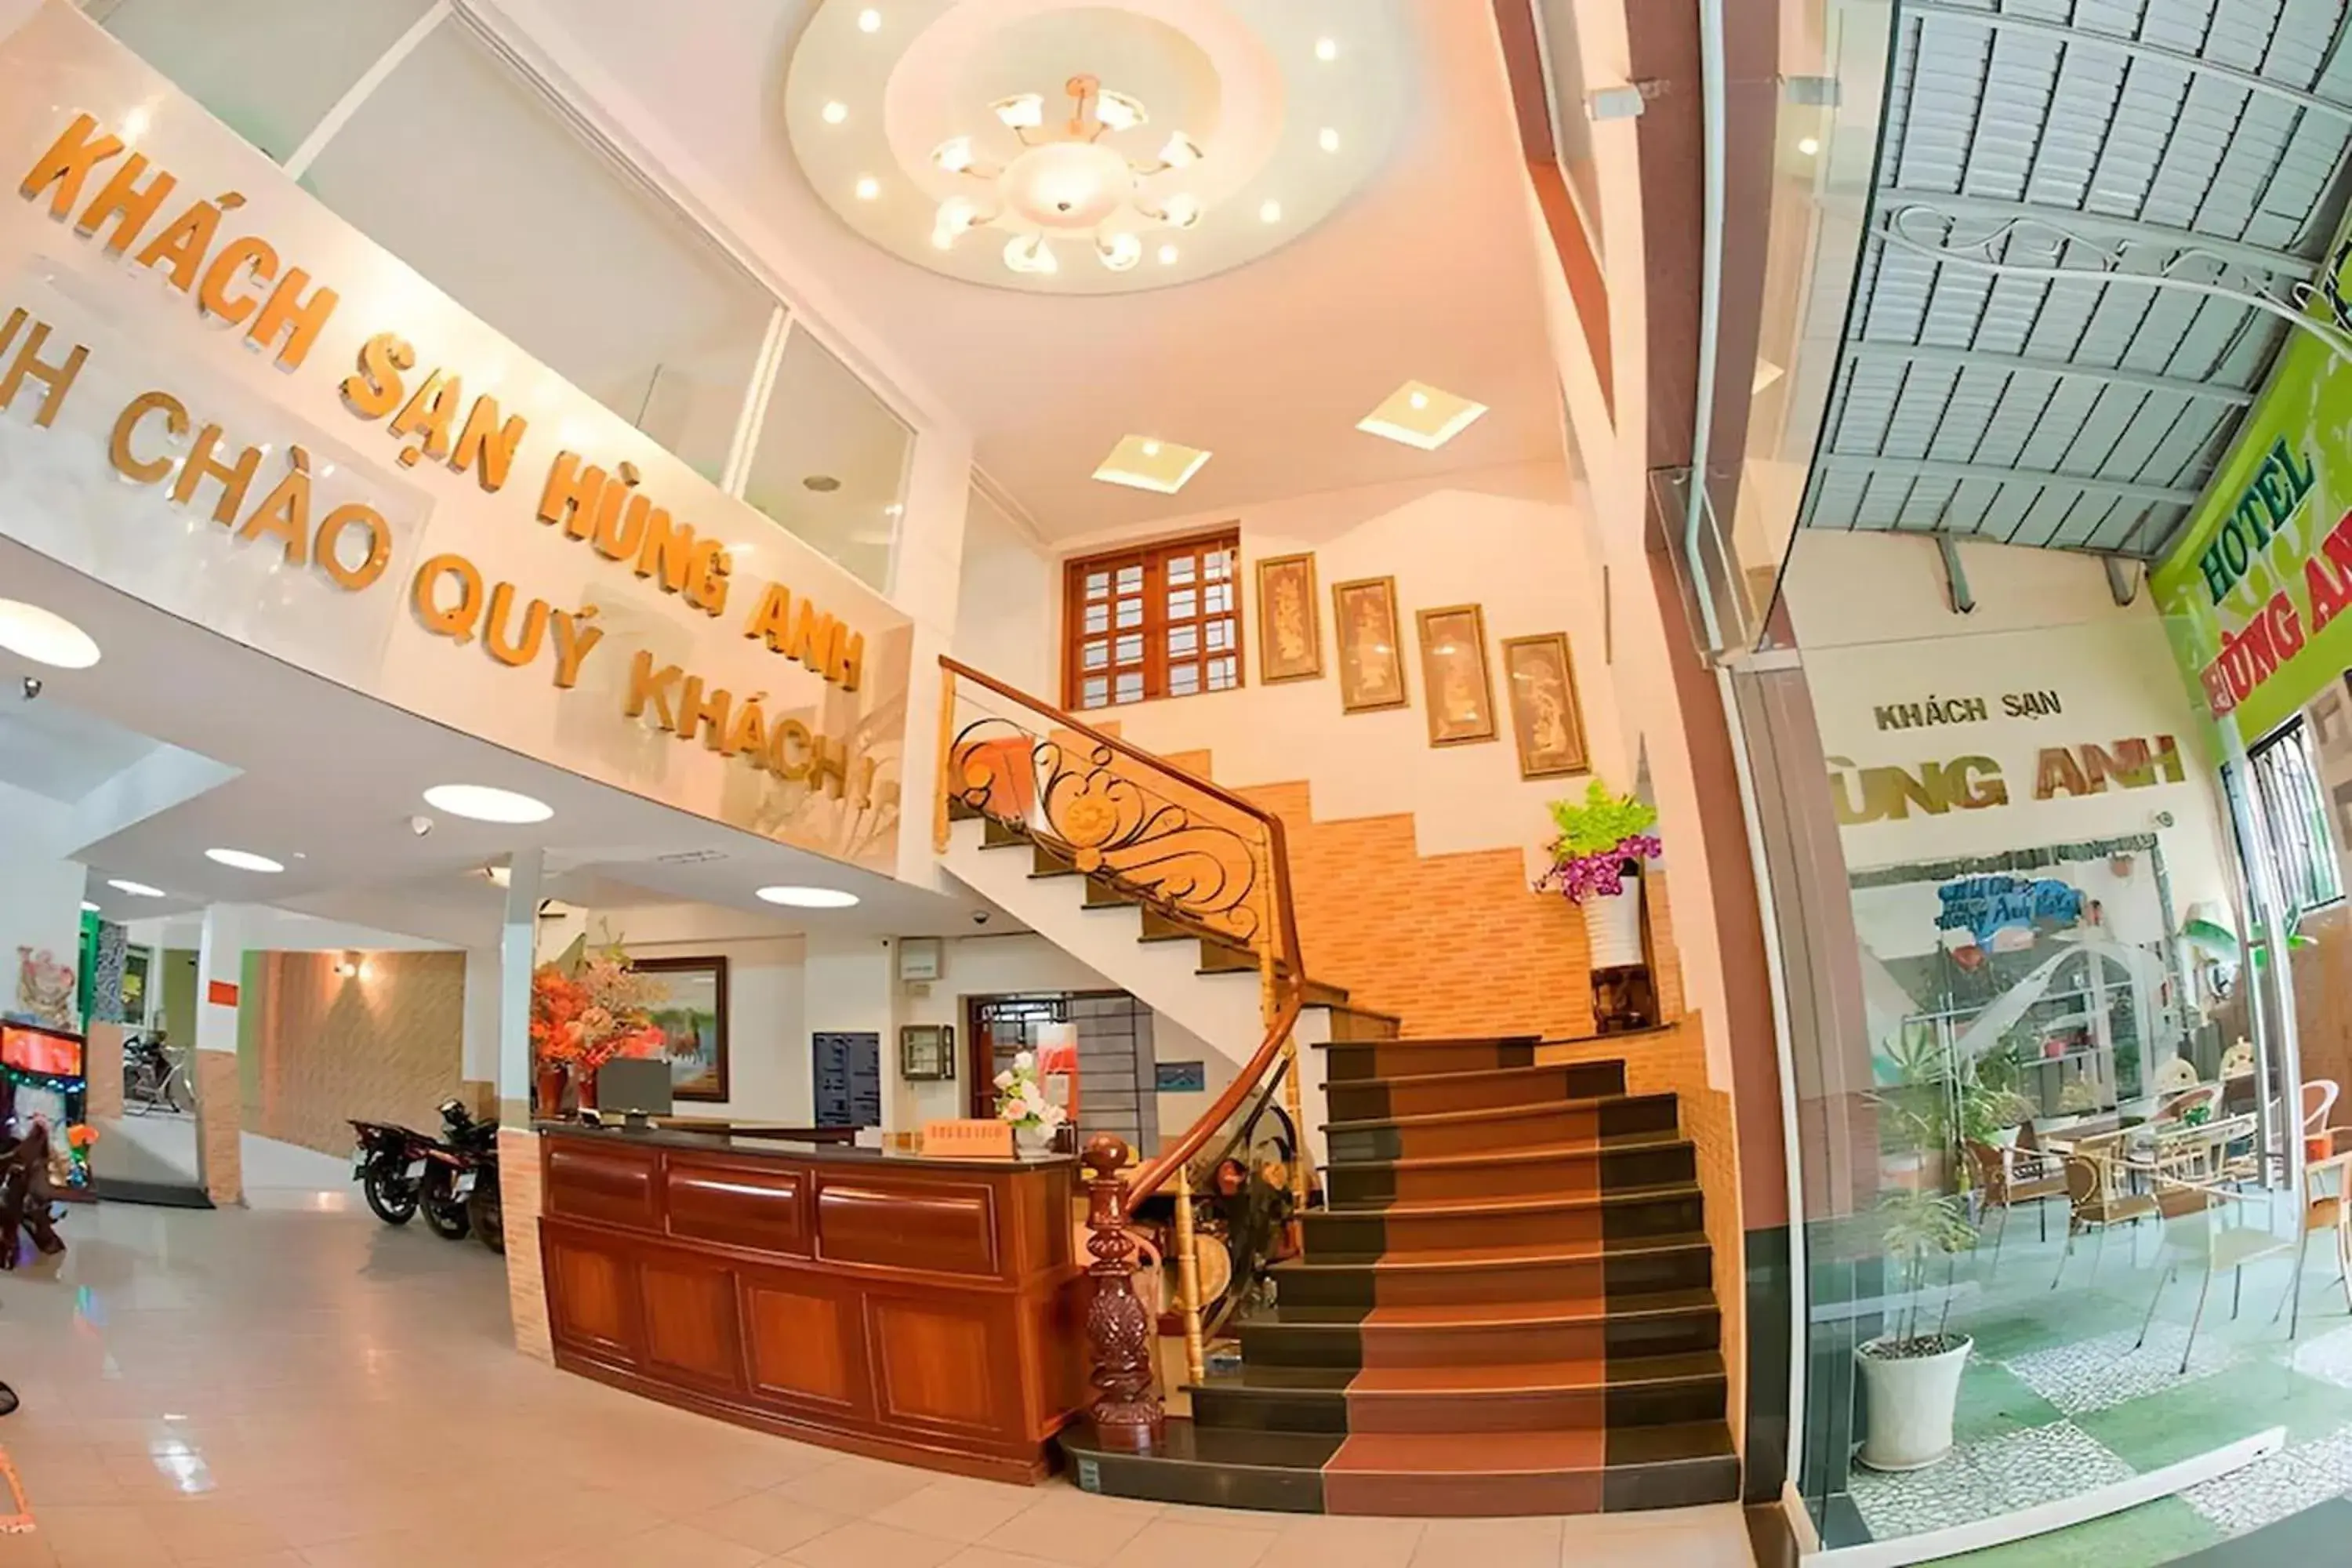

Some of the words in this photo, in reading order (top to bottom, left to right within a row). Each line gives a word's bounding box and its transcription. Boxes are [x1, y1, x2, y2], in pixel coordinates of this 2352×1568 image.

[18, 113, 339, 374] KHÁCH
[338, 332, 527, 493] SẠN
[743, 581, 864, 691] ANH
[108, 390, 392, 591] CHÀO
[411, 553, 604, 689] QUÝ
[2199, 436, 2315, 606] HOTEL
[1826, 755, 2009, 825] ÙNG
[2032, 735, 2187, 800] ANH
[1874, 695, 1988, 731] KHÁCH
[2002, 690, 2063, 720] SẠN
